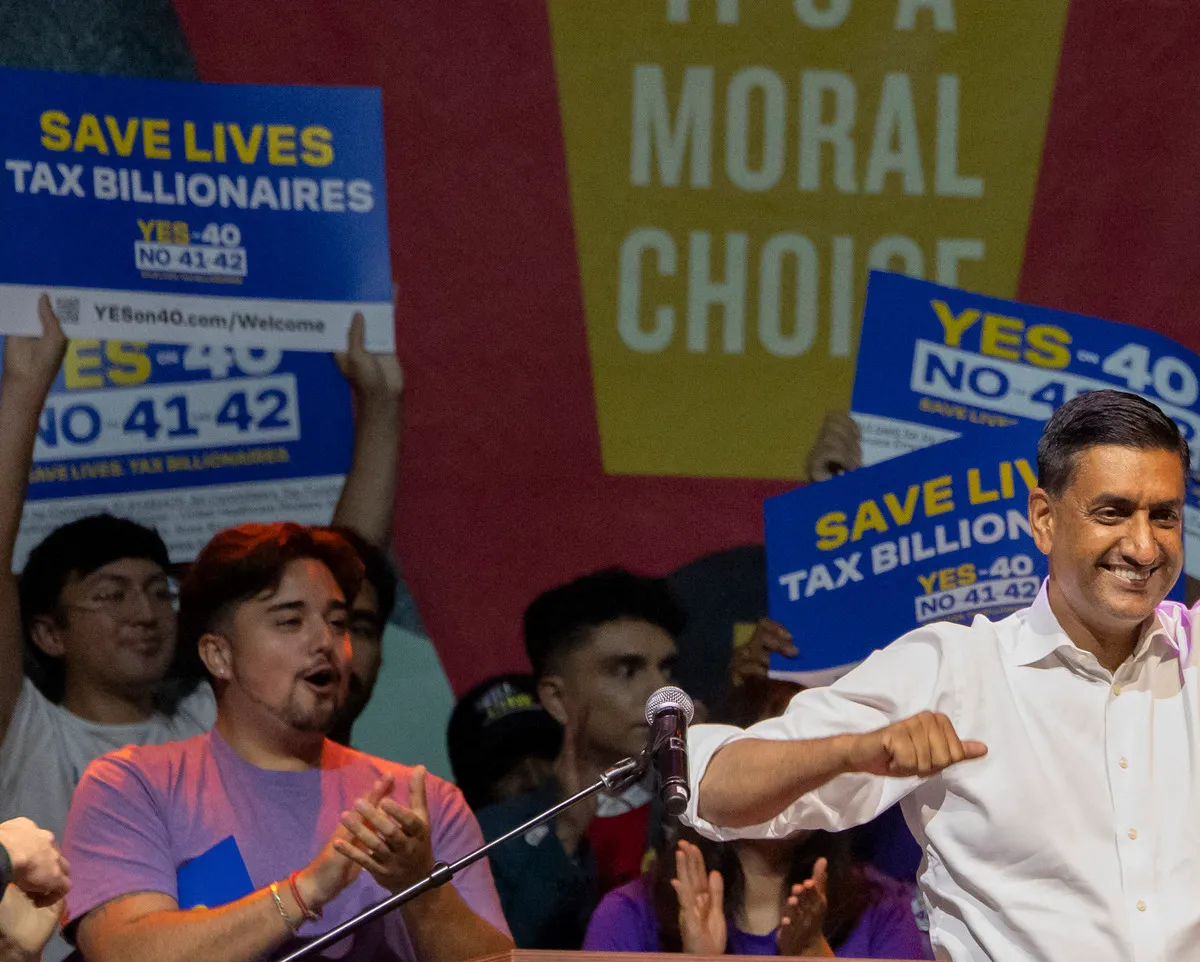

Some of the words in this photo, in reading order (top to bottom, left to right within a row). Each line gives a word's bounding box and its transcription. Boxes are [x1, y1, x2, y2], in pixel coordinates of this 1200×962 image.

[39, 110, 172, 160] SAVE
[183, 121, 335, 167] LIVES
[630, 64, 986, 198] MORAL
[5, 160, 86, 198] TAX
[92, 166, 375, 214] BILLIONAIRES
[137, 218, 190, 245] YES
[202, 222, 242, 248] 40
[139, 248, 171, 266] NO
[180, 251, 205, 270] 41
[214, 253, 243, 271] 42
[93, 304, 327, 334] YESon40.com/Welcome
[64, 340, 153, 390] ES
[924, 352, 1010, 398] NO
[930, 298, 1073, 370] YES
[1101, 341, 1199, 408] 40
[36, 405, 102, 447] NO
[123, 395, 199, 441] 41
[215, 389, 291, 433] 42
[815, 475, 954, 551] SAVE
[966, 457, 1039, 506] LIV
[779, 553, 864, 602] TAX
[871, 508, 1033, 575] BILLION
[917, 562, 977, 595] YES
[989, 554, 1034, 579] 40
[920, 594, 956, 617] NO
[964, 585, 997, 605] 41
[1003, 581, 1037, 600] 42
